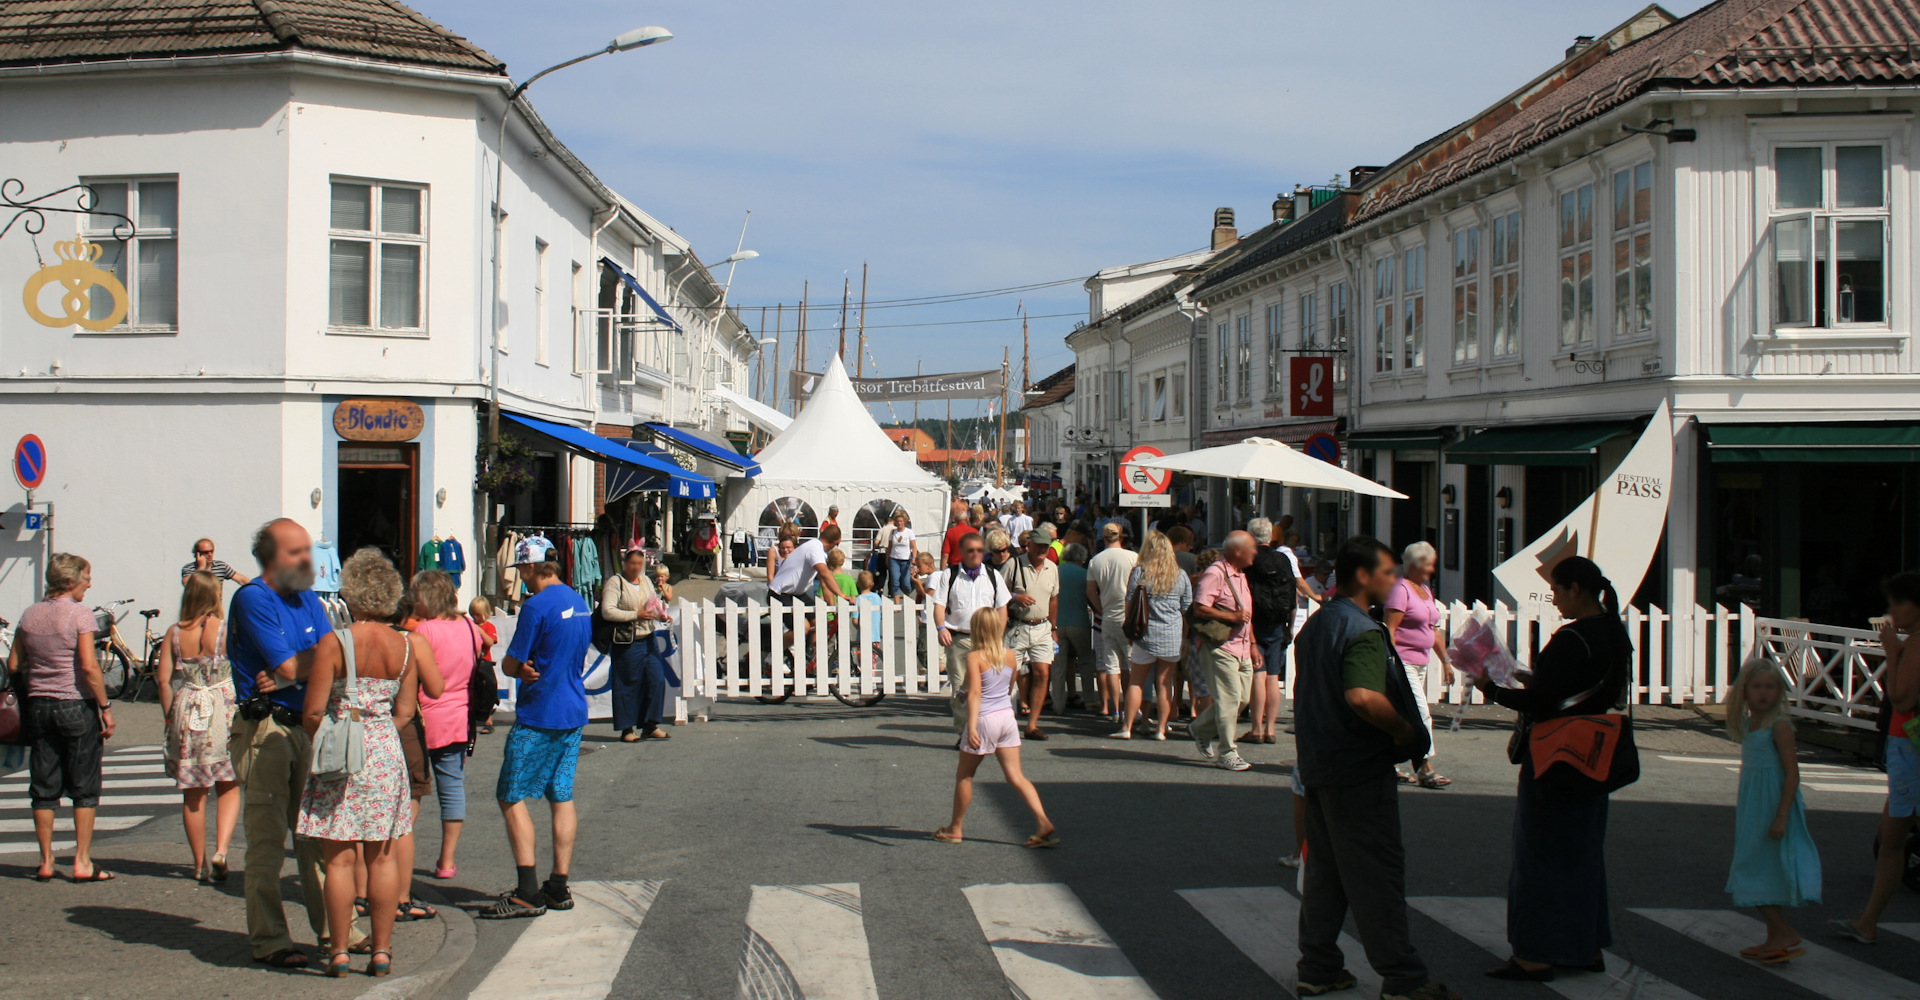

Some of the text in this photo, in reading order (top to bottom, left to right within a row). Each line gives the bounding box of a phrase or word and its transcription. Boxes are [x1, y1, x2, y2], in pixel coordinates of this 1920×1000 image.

[853, 376, 987, 395] isør Trebåtfestival
[347, 406, 409, 431] Blondie
[1617, 473, 1663, 486] FESTIVAL
[1616, 480, 1662, 499] PASS
[30, 516, 37, 527] P
[1528, 592, 1554, 603] RIS
